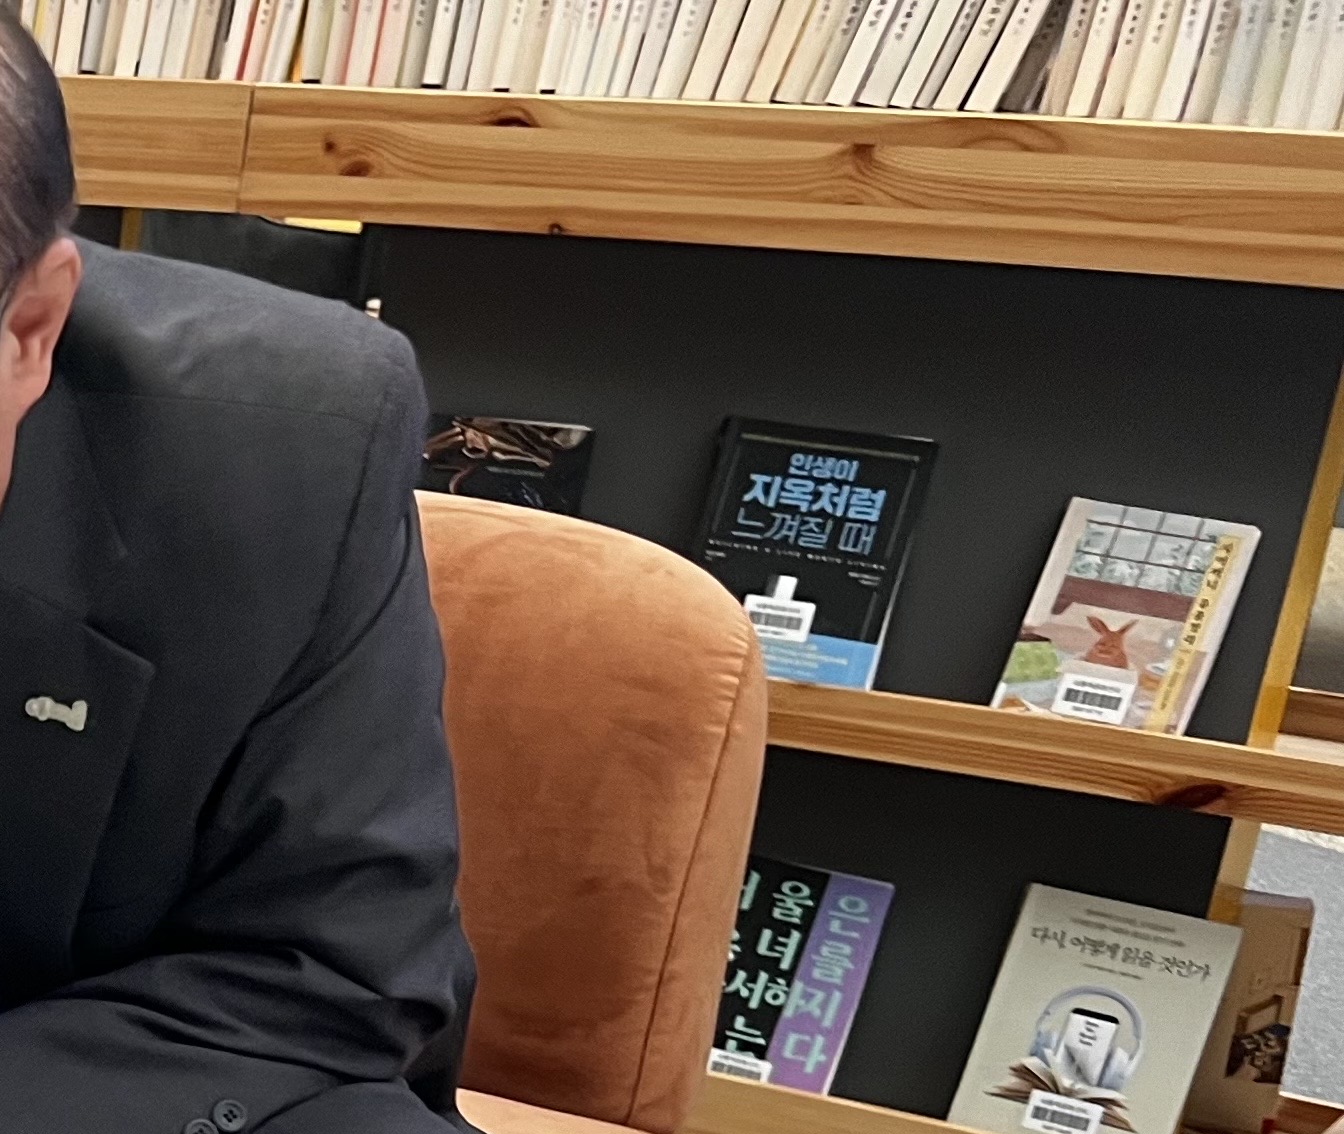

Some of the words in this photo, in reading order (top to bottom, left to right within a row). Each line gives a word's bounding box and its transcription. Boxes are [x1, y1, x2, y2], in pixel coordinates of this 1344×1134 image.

[788, 452, 860, 482] 인생이
[742, 473, 888, 522] 지옥처럼
[731, 507, 835, 550] 느껴질
[838, 522, 878, 555] 때
[722, 969, 843, 1030] 서하지
[725, 1015, 827, 1074] 는다
